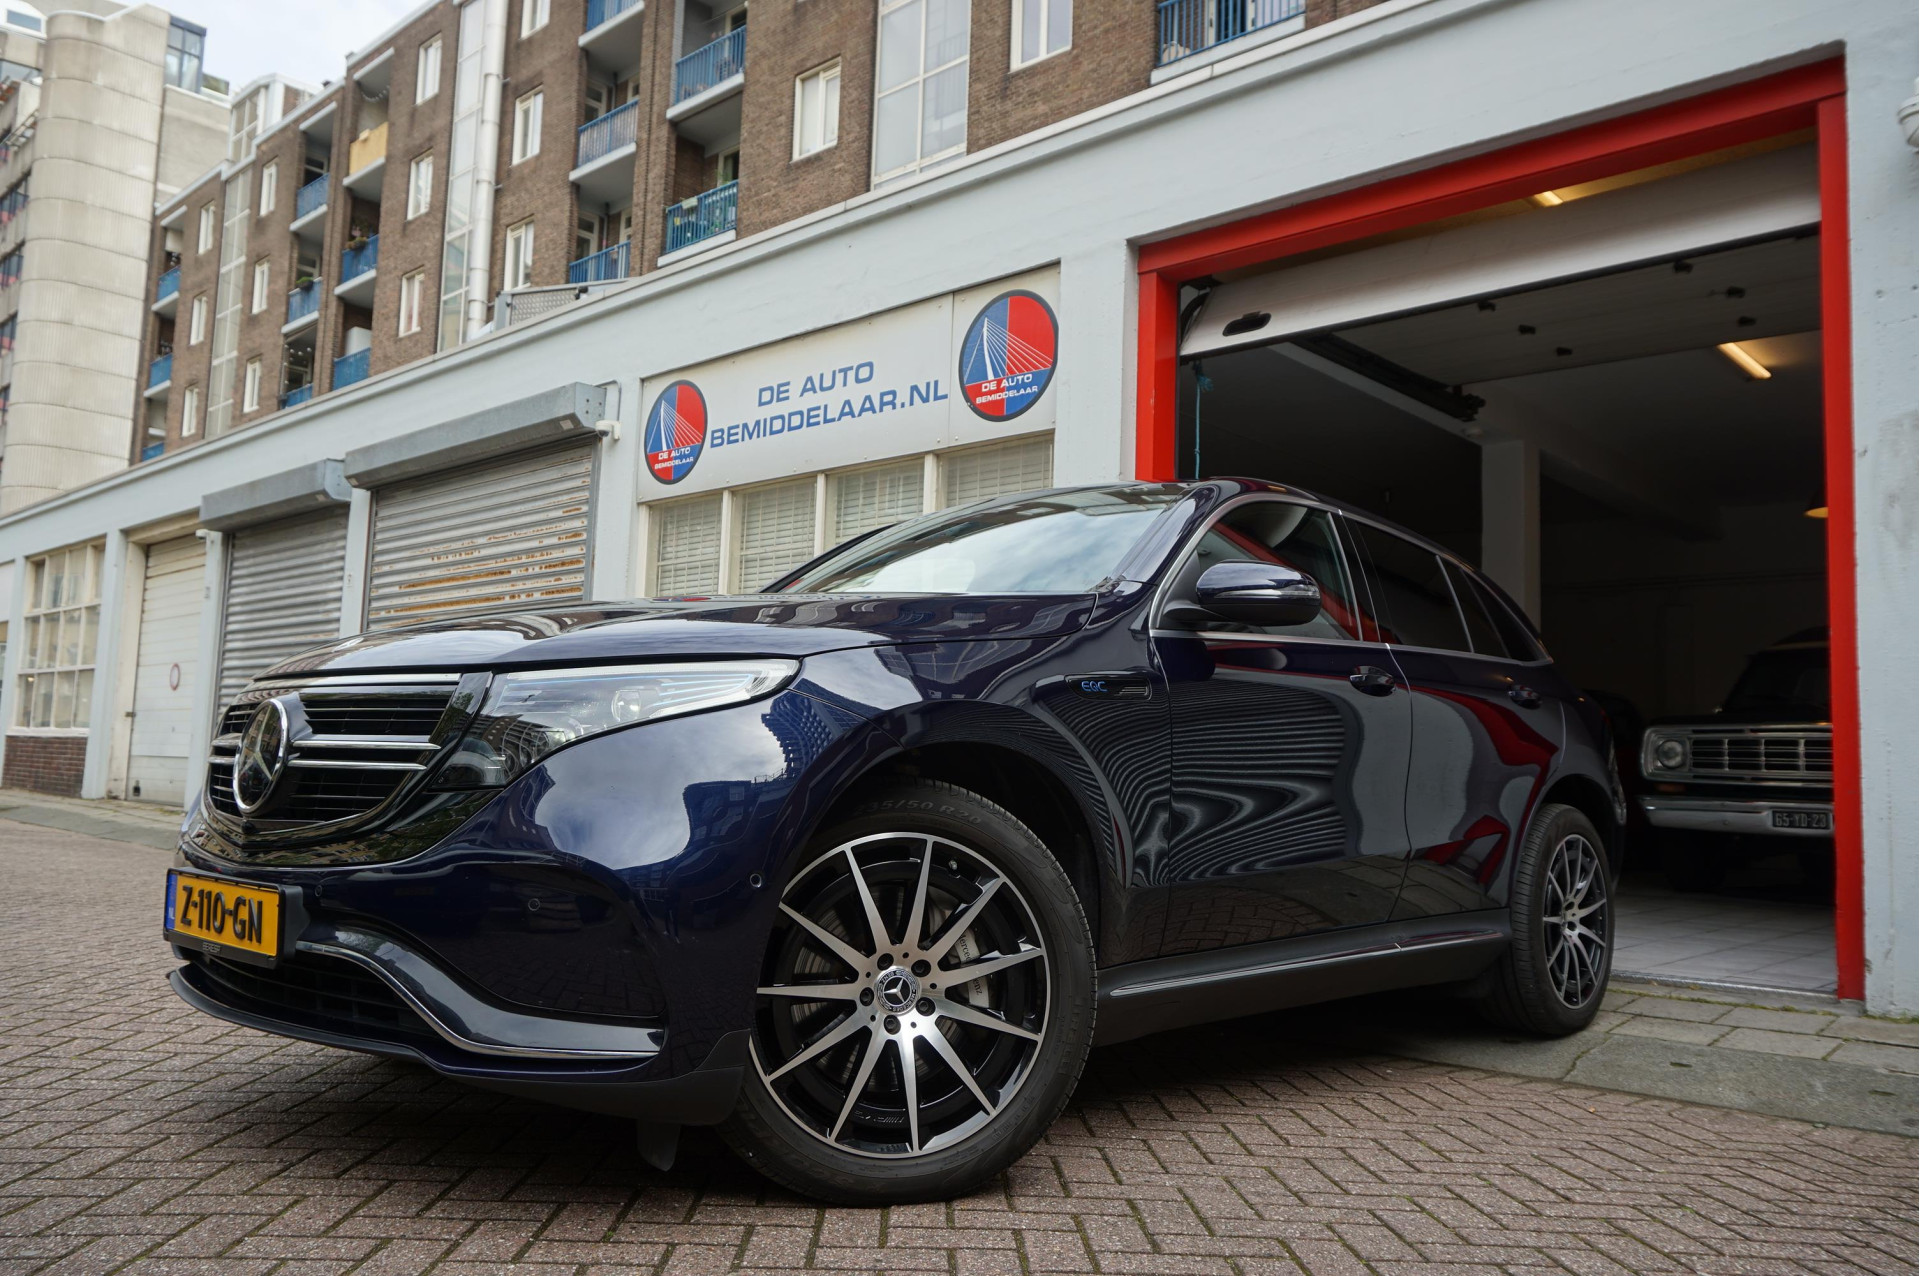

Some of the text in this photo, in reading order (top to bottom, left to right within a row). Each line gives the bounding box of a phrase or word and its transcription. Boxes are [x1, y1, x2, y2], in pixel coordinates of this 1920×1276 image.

[757, 361, 874, 407] DE AUTO
[981, 373, 1033, 393] DE AUTO
[975, 385, 1039, 404] BEMIDDELAAR
[710, 379, 949, 449] BEMIDDELAAR.NL
[654, 456, 694, 470] BEMIDDELAAR
[658, 446, 691, 461] DE AUTO
[1081, 680, 1108, 692] EQC
[180, 885, 264, 945] Z-110-GN
